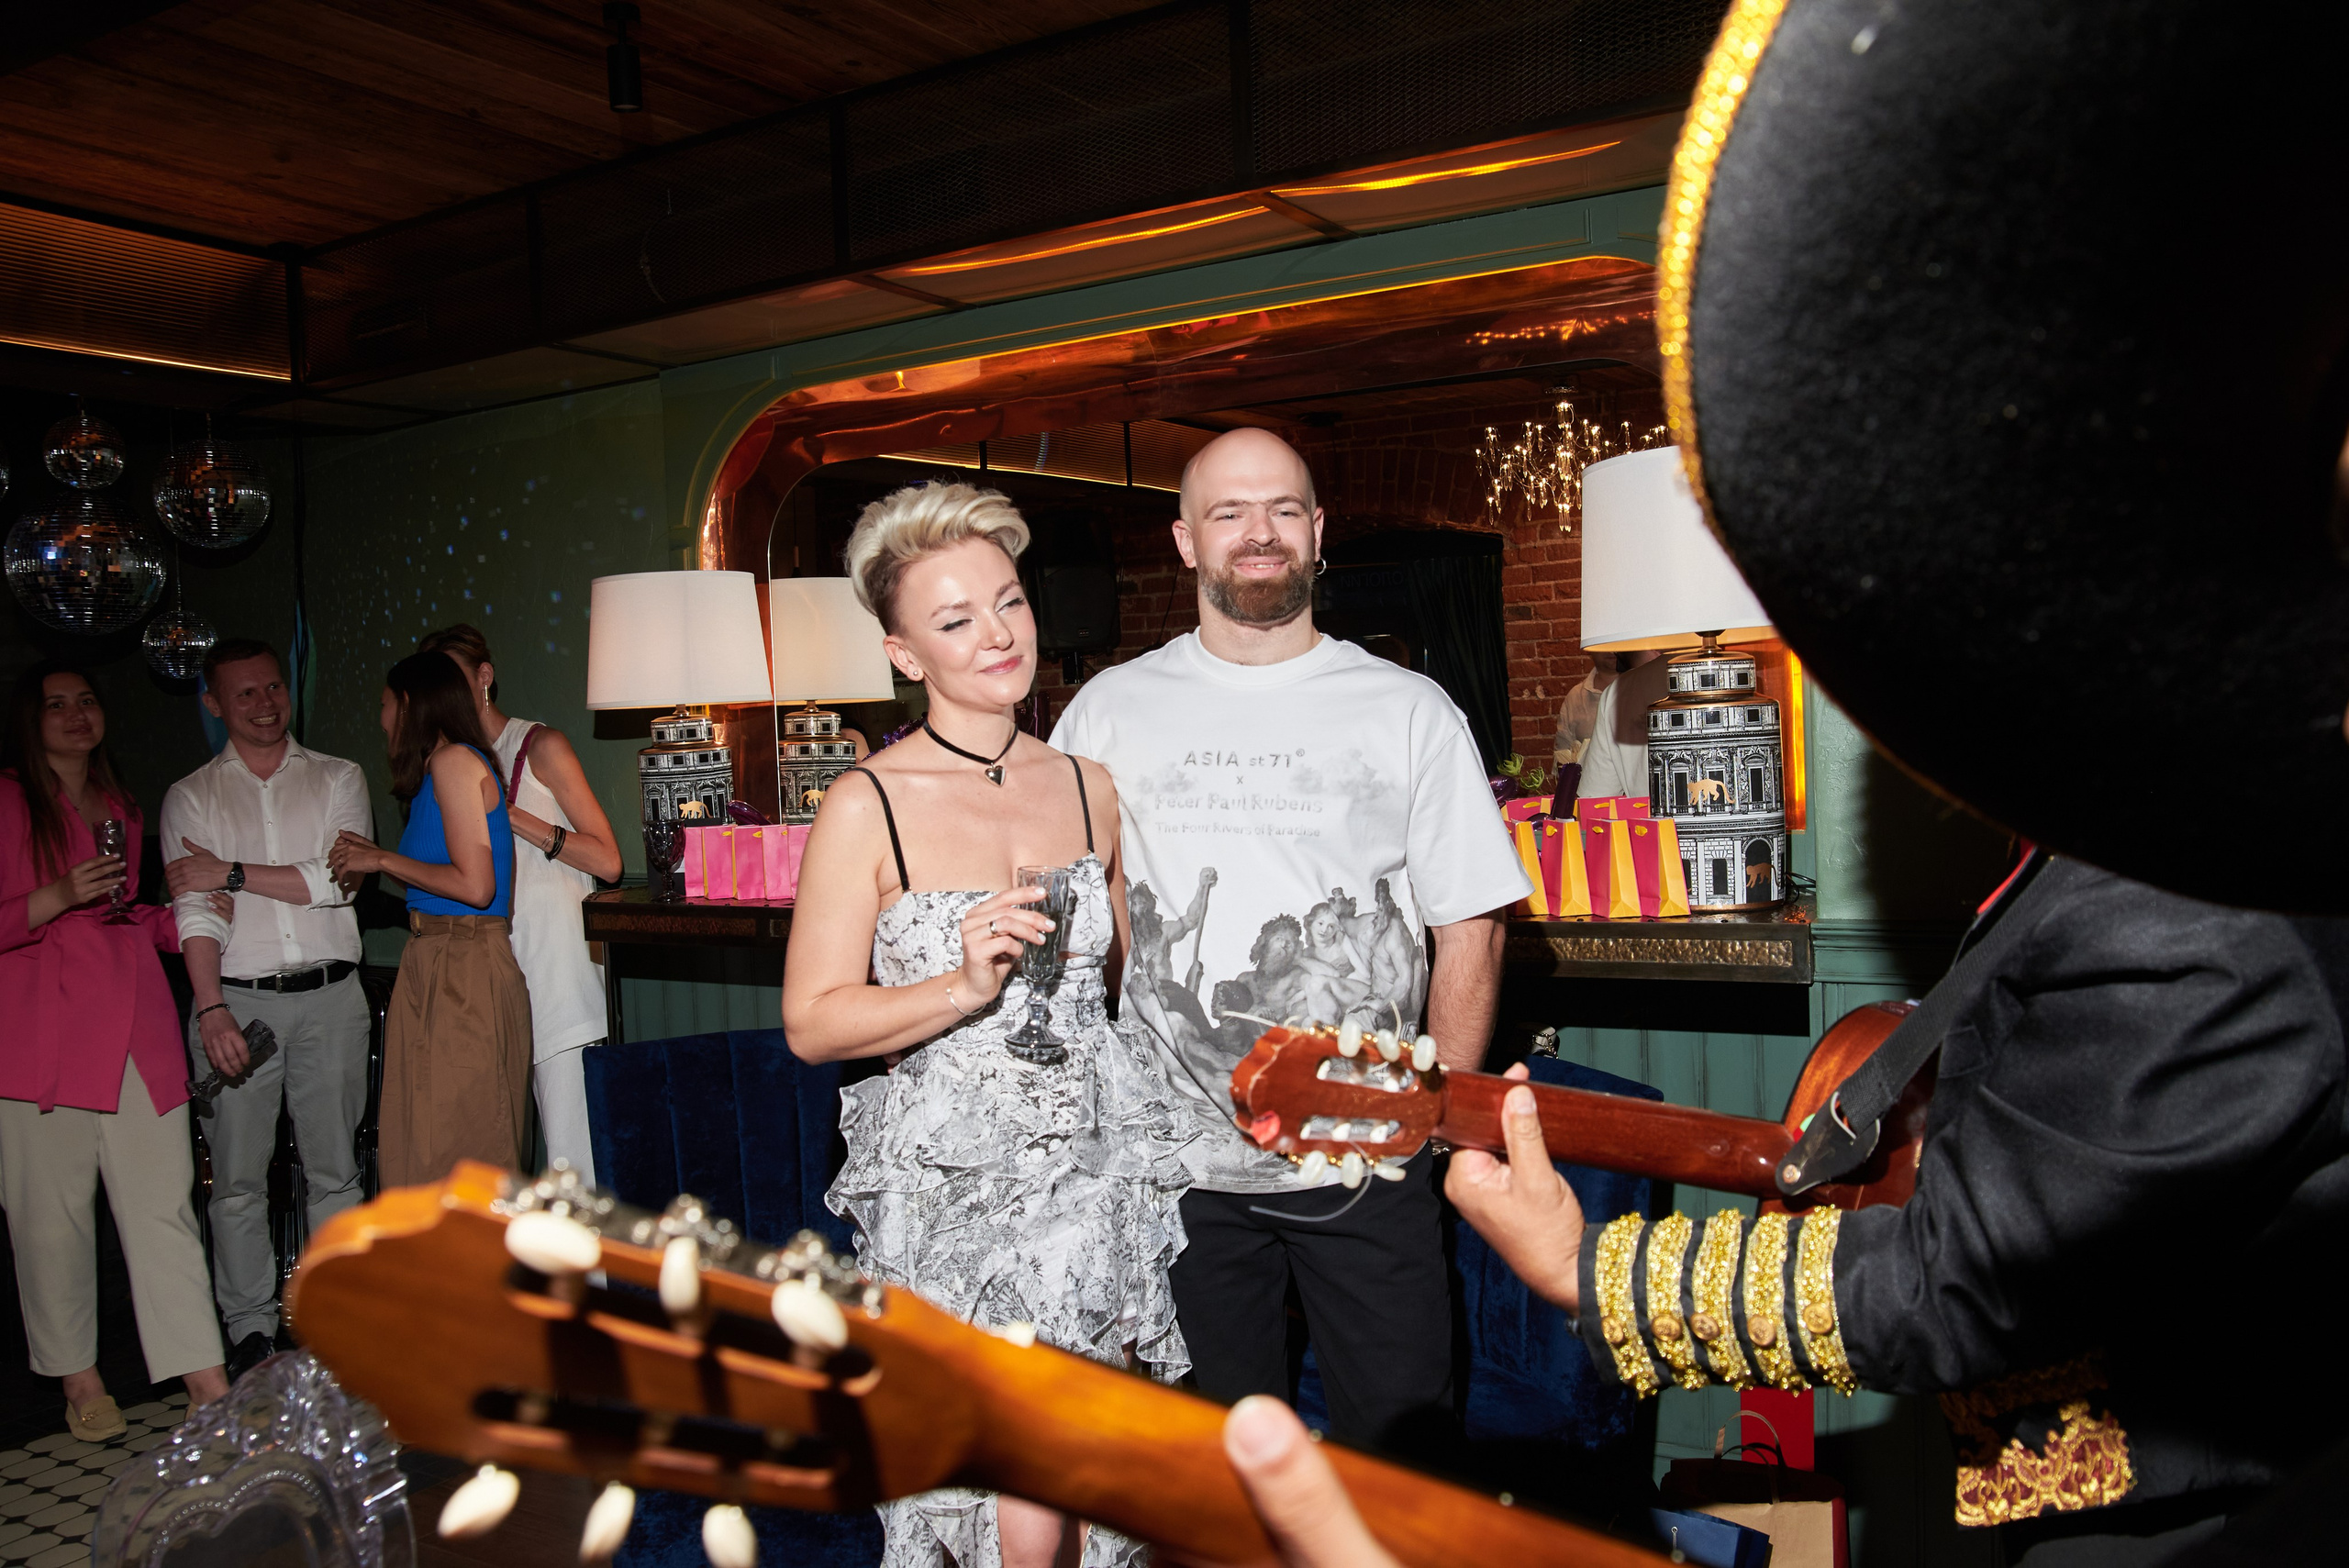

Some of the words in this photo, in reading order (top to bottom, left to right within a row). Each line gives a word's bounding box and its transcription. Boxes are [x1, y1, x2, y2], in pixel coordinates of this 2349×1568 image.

[1183, 750, 1240, 767] ASIA
[1154, 794, 1204, 810] Peter
[1207, 792, 1247, 811] Paul
[1251, 793, 1323, 813] Rubens
[1154, 822, 1178, 834] The
[1182, 822, 1209, 834] Four
[1212, 822, 1252, 835] Rivers
[1267, 824, 1321, 838] Paradise
